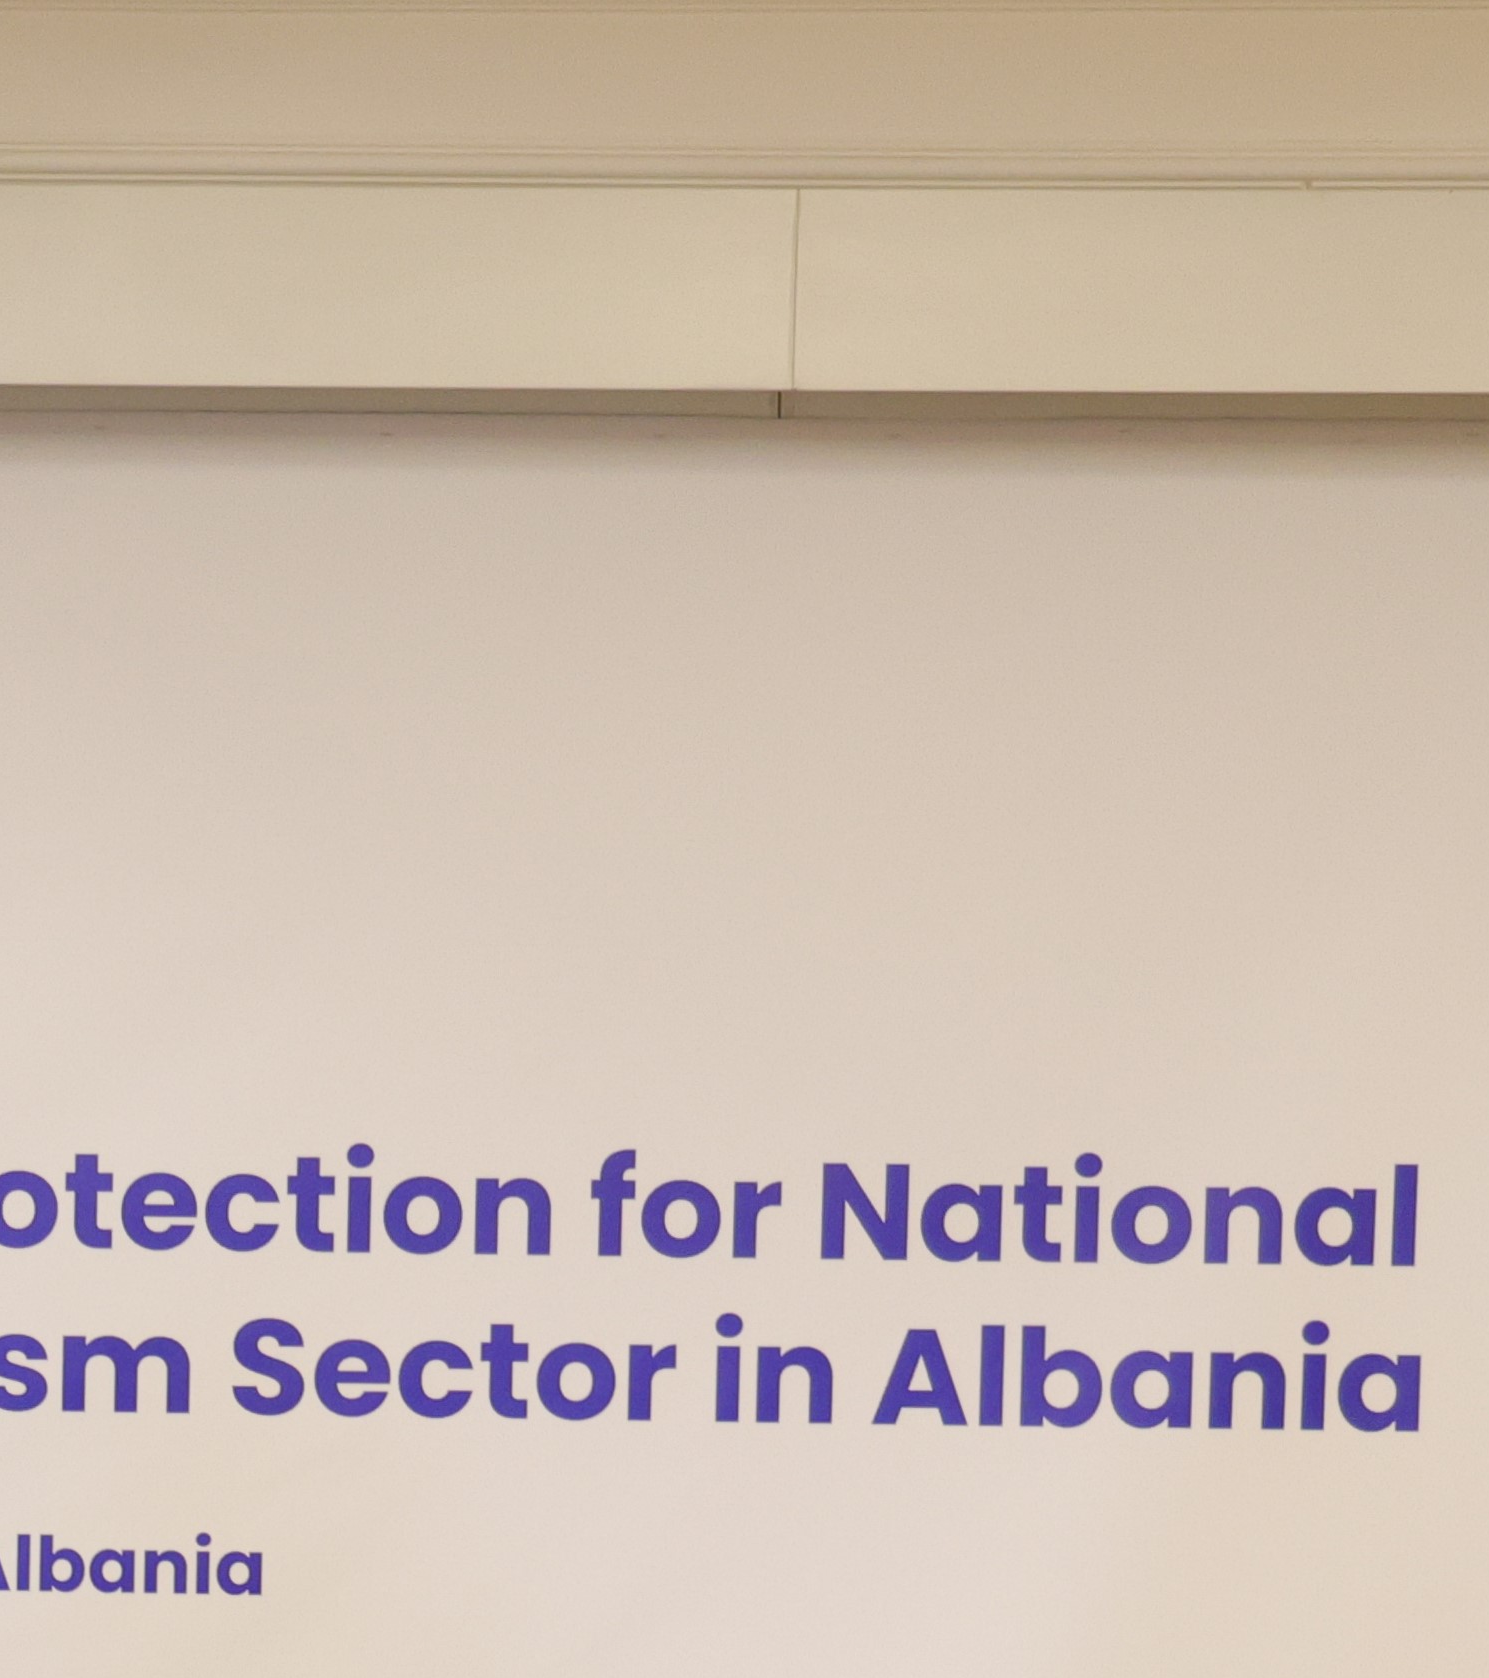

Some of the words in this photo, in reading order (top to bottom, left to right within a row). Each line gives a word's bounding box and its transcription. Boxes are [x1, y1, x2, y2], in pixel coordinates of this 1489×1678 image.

[591, 1149, 782, 1258] for
[821, 1153, 1418, 1266] National
[233, 1318, 676, 1421] Sector
[716, 1313, 833, 1423] in
[873, 1321, 1421, 1432] Albania
